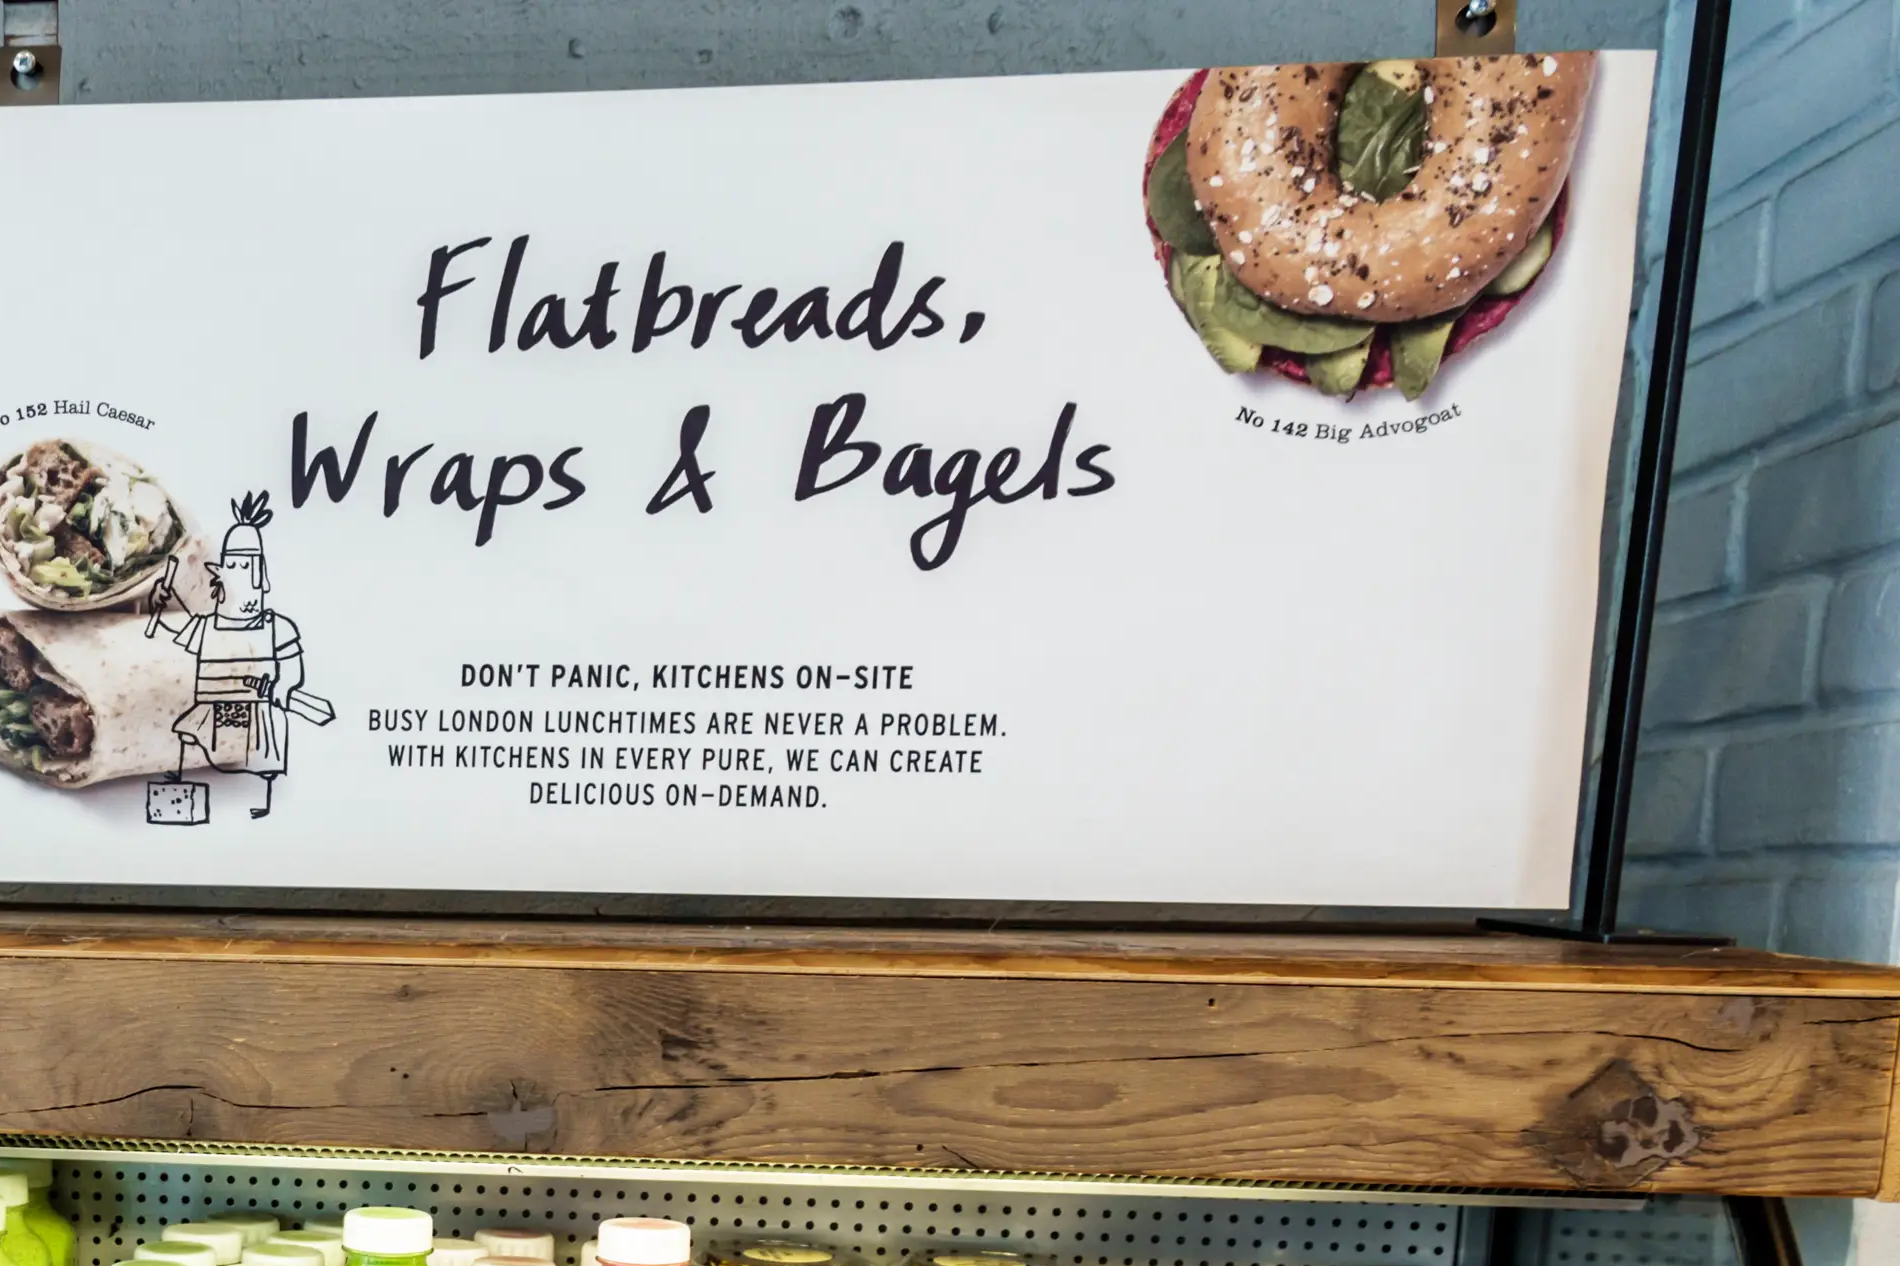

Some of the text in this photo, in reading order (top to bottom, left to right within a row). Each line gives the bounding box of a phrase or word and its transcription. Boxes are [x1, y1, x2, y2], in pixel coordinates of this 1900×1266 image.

[417, 234, 986, 359] Flatbreads,
[16, 403, 48, 421] 152
[54, 400, 90, 414] Hail
[96, 402, 155, 430] Caesar
[1235, 402, 1462, 443] No 142 Big Advogoat
[291, 392, 1116, 572] Wraps & Bagels
[460, 663, 914, 692] DON'T PANIC, KITCHENS ON-SITE
[368, 708, 1007, 737] BUSY LONDON LUNCHTIMES ARE NEVER A PROBLEM.
[387, 744, 983, 775] WITH KITCHENS IN EVERY PURE, WE CAN CREATE
[529, 781, 827, 809] DELICIOUS ON-DEMAND.
